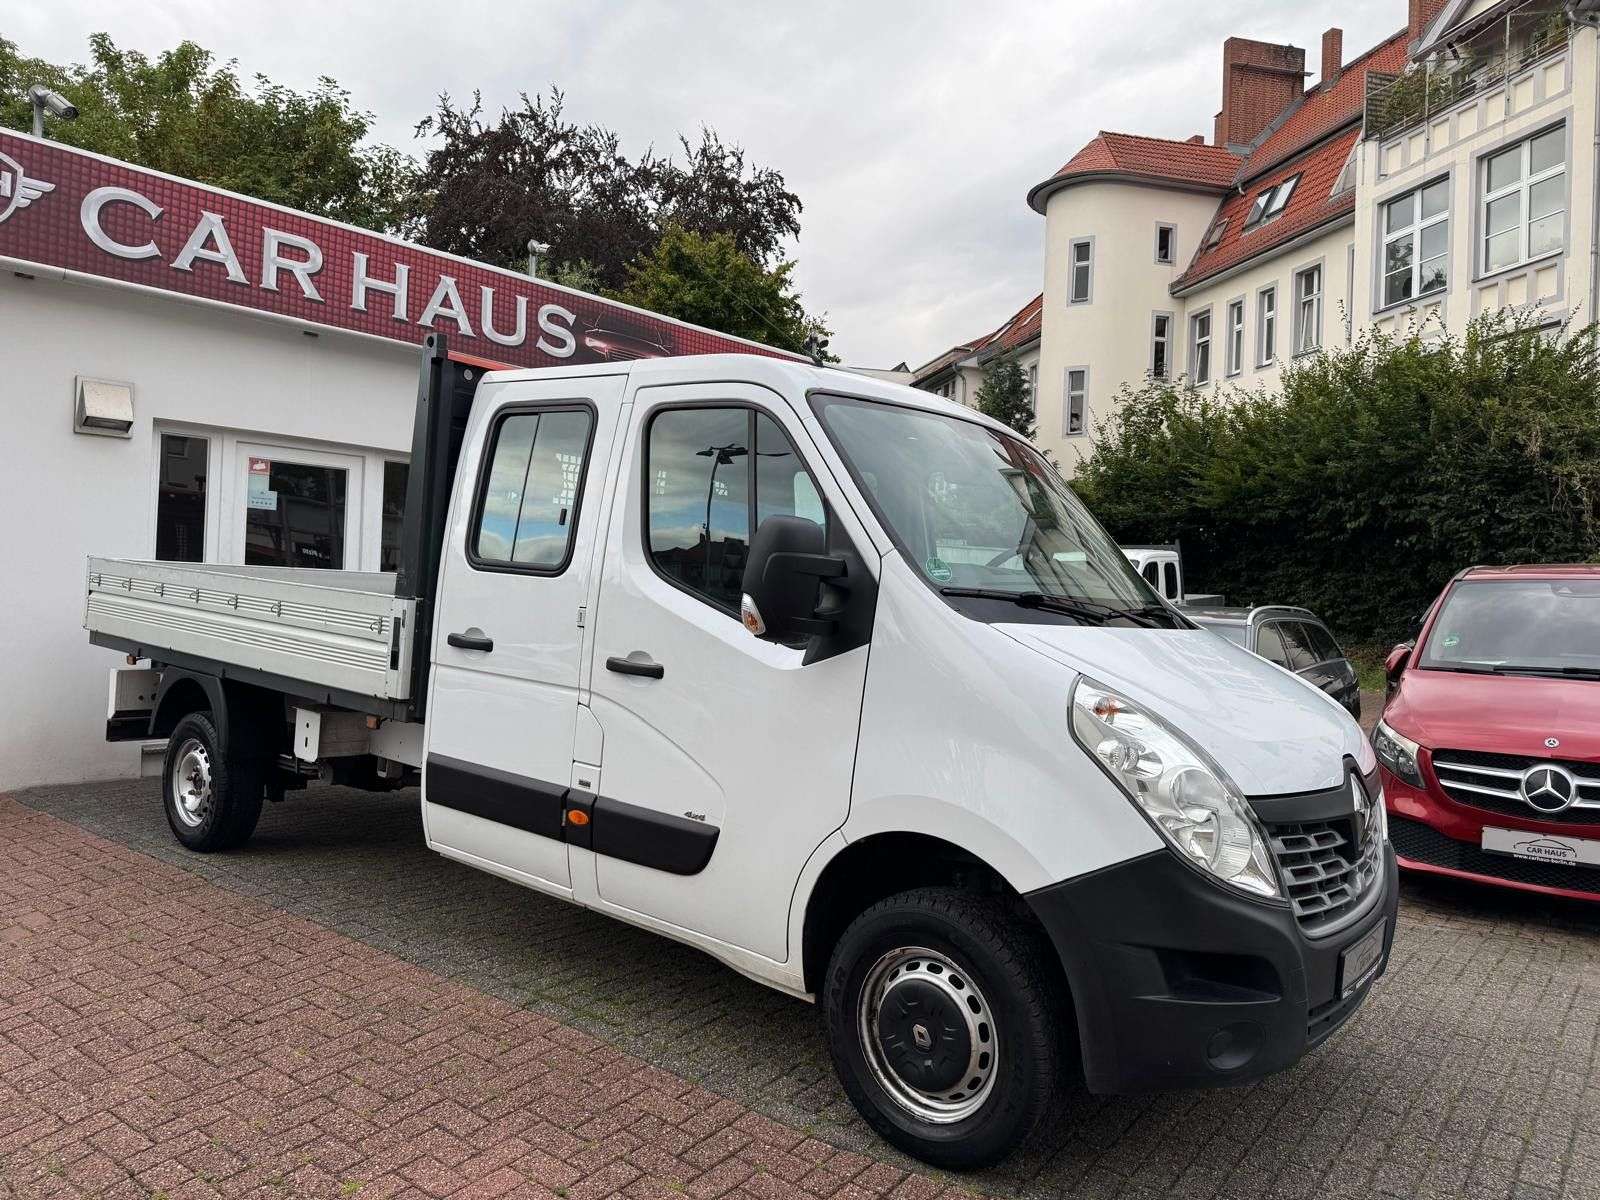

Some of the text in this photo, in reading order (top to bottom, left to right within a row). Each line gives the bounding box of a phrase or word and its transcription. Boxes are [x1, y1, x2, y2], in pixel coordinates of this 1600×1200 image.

[80, 186, 577, 359] CAR HAUS
[1526, 846, 1568, 858] CAR HAUS
[1513, 854, 1577, 866] www.carhaus-berlin.de
